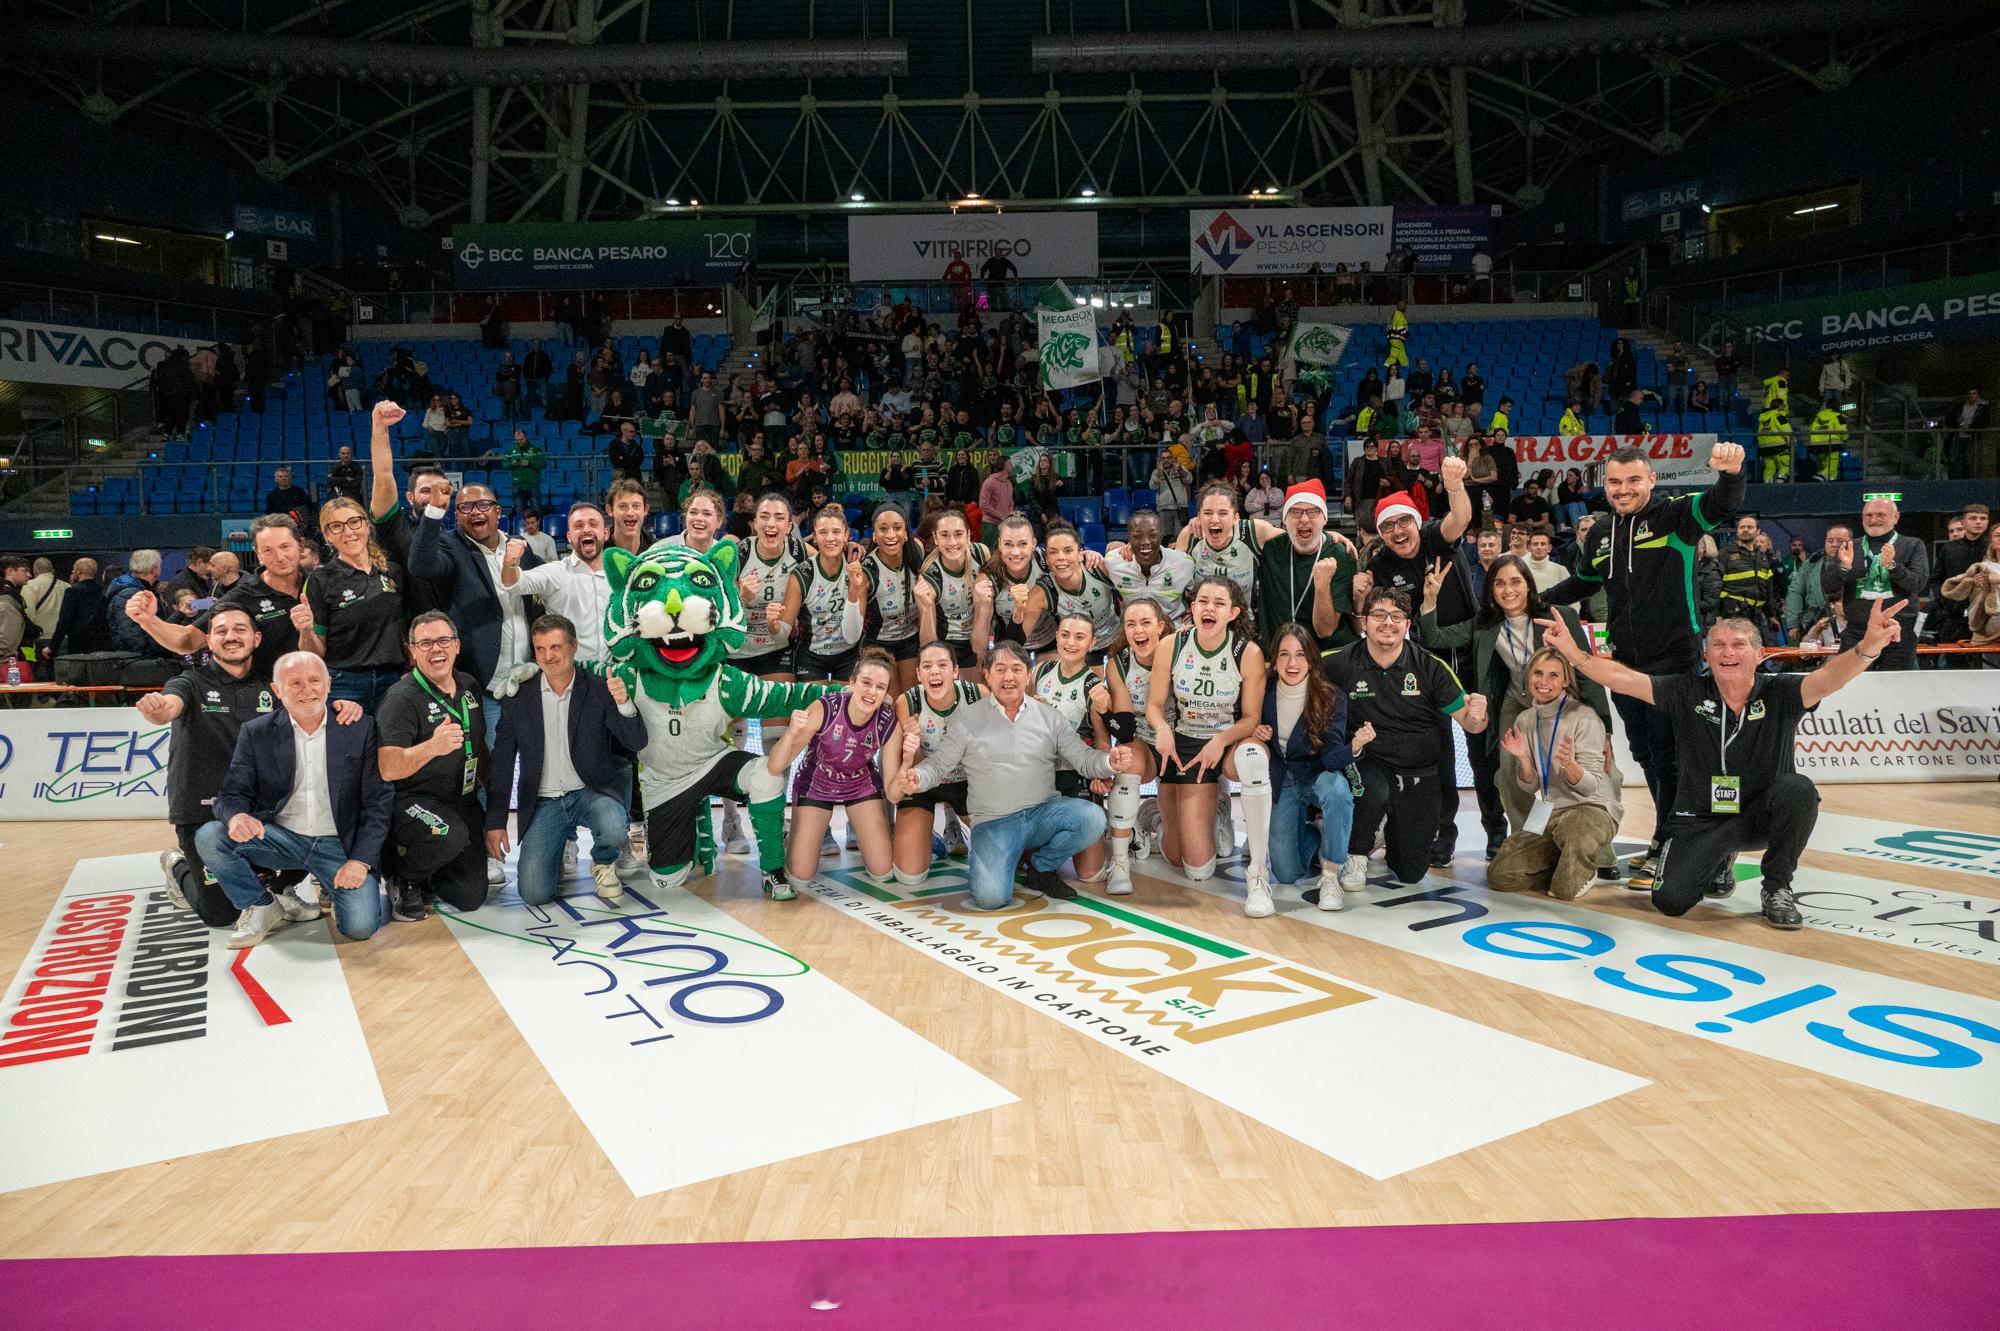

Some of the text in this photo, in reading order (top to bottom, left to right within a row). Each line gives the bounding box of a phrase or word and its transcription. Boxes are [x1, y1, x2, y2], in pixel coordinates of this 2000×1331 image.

[1660, 187, 1699, 207] BAR
[275, 214, 315, 236] BAR
[1257, 223, 1383, 237] VL ASCENSORI
[489, 245, 667, 262] BCC BANCA PESARO
[913, 238, 1031, 258] VITRIFRIGO
[1257, 240, 1326, 254] PESARO
[1042, 310, 1092, 324] MEGABOX
[1822, 303, 1935, 336] BANCA
[0, 327, 172, 372] RIVACO
[1821, 330, 1934, 352] GRUPPO BCC ICCREA
[763, 585, 776, 602] 8
[829, 597, 845, 614] 22
[1194, 678, 1214, 696] 20
[668, 718, 680, 736] 0
[1795, 708, 2000, 736] dulati del Savi
[48, 730, 170, 774] TEK
[841, 749, 854, 763] 7
[1796, 754, 2000, 768] USTRIA CARTONE OND
[34, 780, 170, 799] IMPIA
[1715, 788, 1736, 799] STAFF
[1842, 846, 2000, 875] enginee
[1890, 890, 2000, 914] CA
[1801, 915, 1982, 956] uova vita
[553, 880, 785, 1025] EKNO
[500, 890, 675, 1046] PIANTI
[807, 880, 850, 901] TEMI
[845, 901, 870, 912] DI
[865, 911, 998, 975] IMBALLAGGIO
[997, 975, 1036, 990] IN
[1033, 993, 1170, 1057] CARTONE
[0, 894, 135, 1068] COSTRUZIONI
[1166, 997, 1214, 1022] s.r.l.
